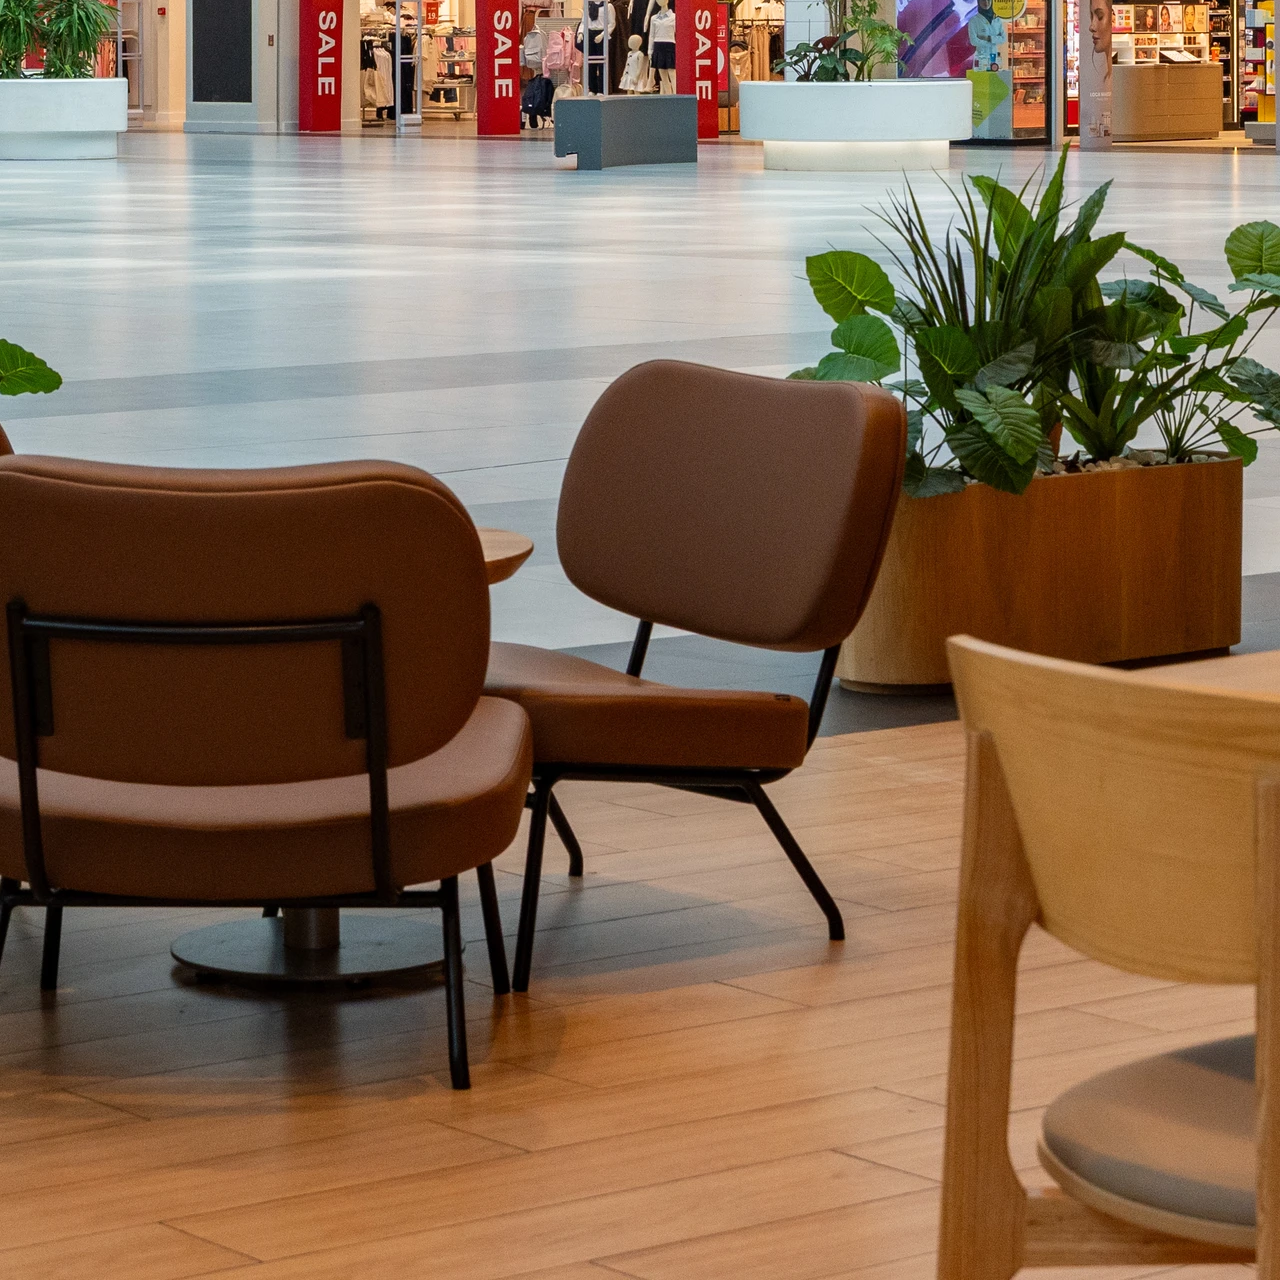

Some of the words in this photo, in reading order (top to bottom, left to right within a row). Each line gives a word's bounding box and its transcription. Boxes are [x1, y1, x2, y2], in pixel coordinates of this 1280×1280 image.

[318, 10, 337, 96] SALE
[493, 10, 513, 99] SALE
[695, 9, 712, 100] SALE
